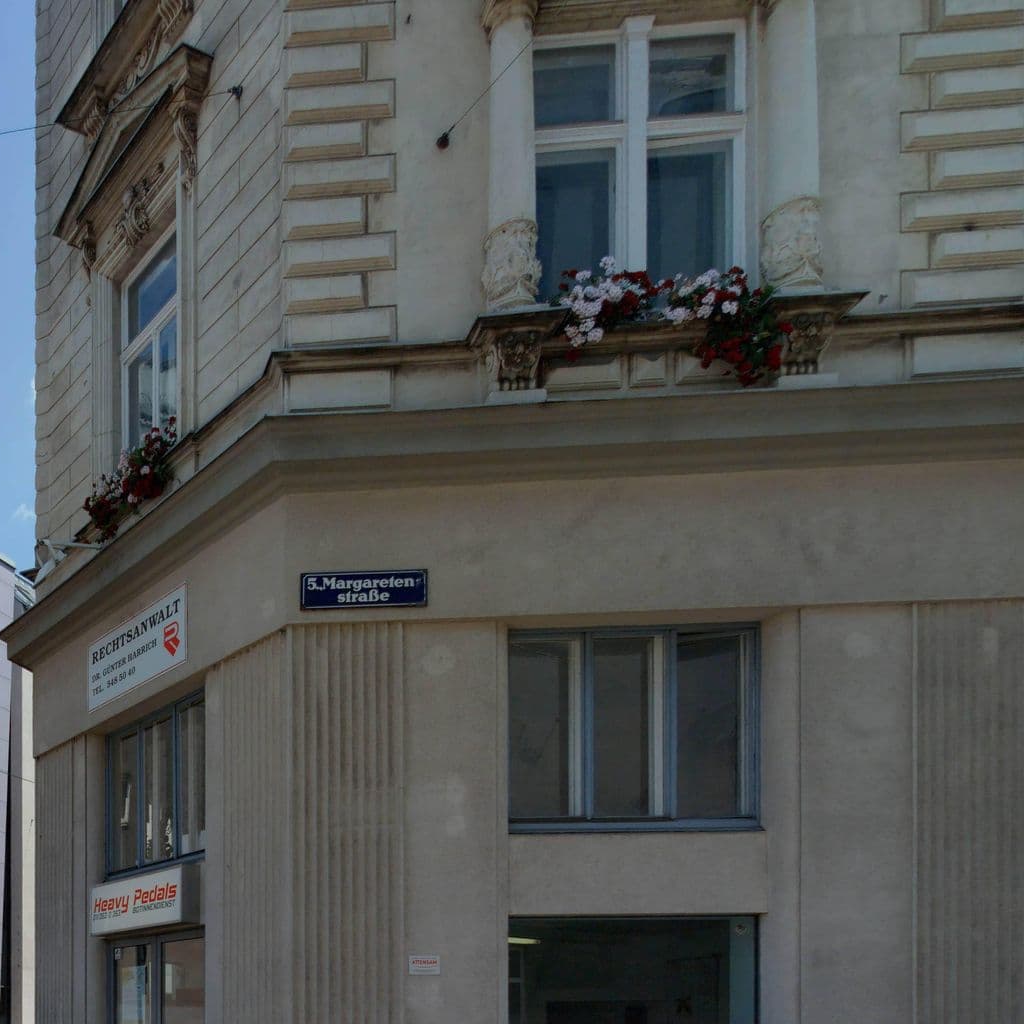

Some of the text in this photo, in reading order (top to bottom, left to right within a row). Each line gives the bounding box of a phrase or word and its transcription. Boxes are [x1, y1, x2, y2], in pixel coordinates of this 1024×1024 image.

[337, 590, 390, 603] straße
[91, 598, 181, 665] RECHTSANWALT
[93, 882, 178, 914] Heavy Pedals
